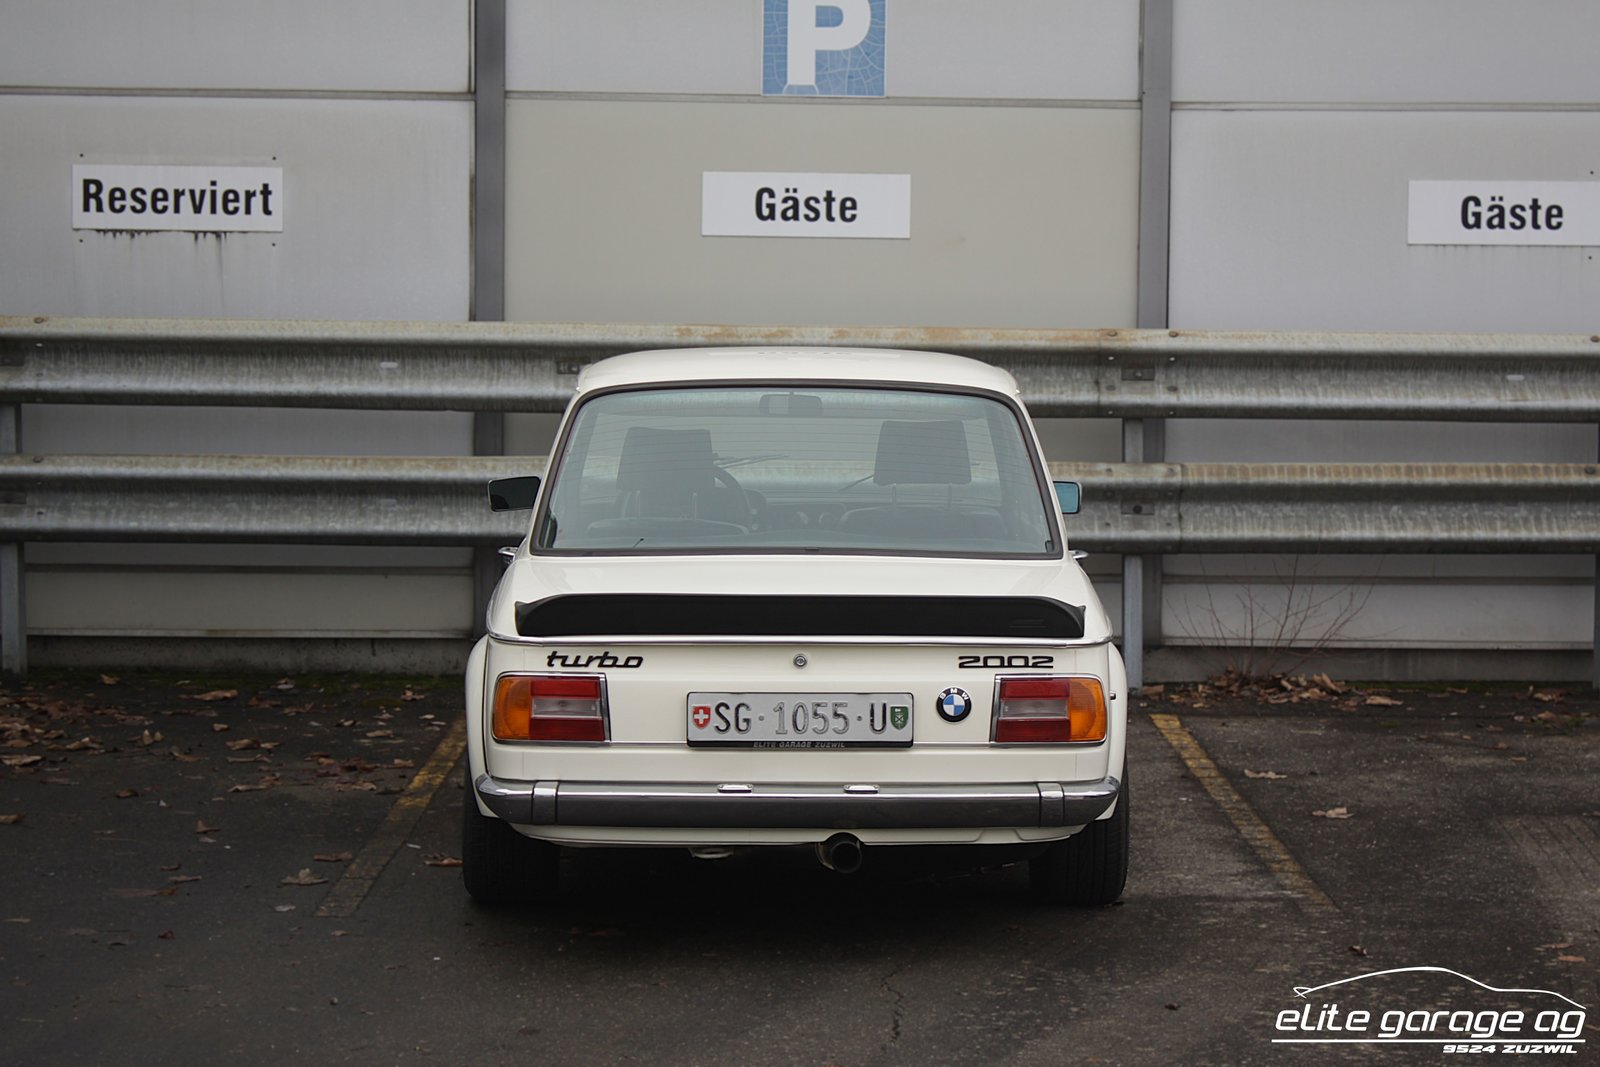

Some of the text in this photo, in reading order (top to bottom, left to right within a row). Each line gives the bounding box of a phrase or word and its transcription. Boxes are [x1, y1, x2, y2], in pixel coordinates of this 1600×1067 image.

[787, 0, 871, 86] P
[82, 178, 273, 216] Reserviert
[754, 186, 858, 223] Gäste
[1460, 195, 1564, 231] Gäste
[546, 650, 644, 669] turbo
[957, 655, 1054, 669] 2002
[713, 701, 752, 735] SG
[772, 701, 850, 735] 1055
[753, 741, 846, 749] ELITE GARAGE ZUZWIL
